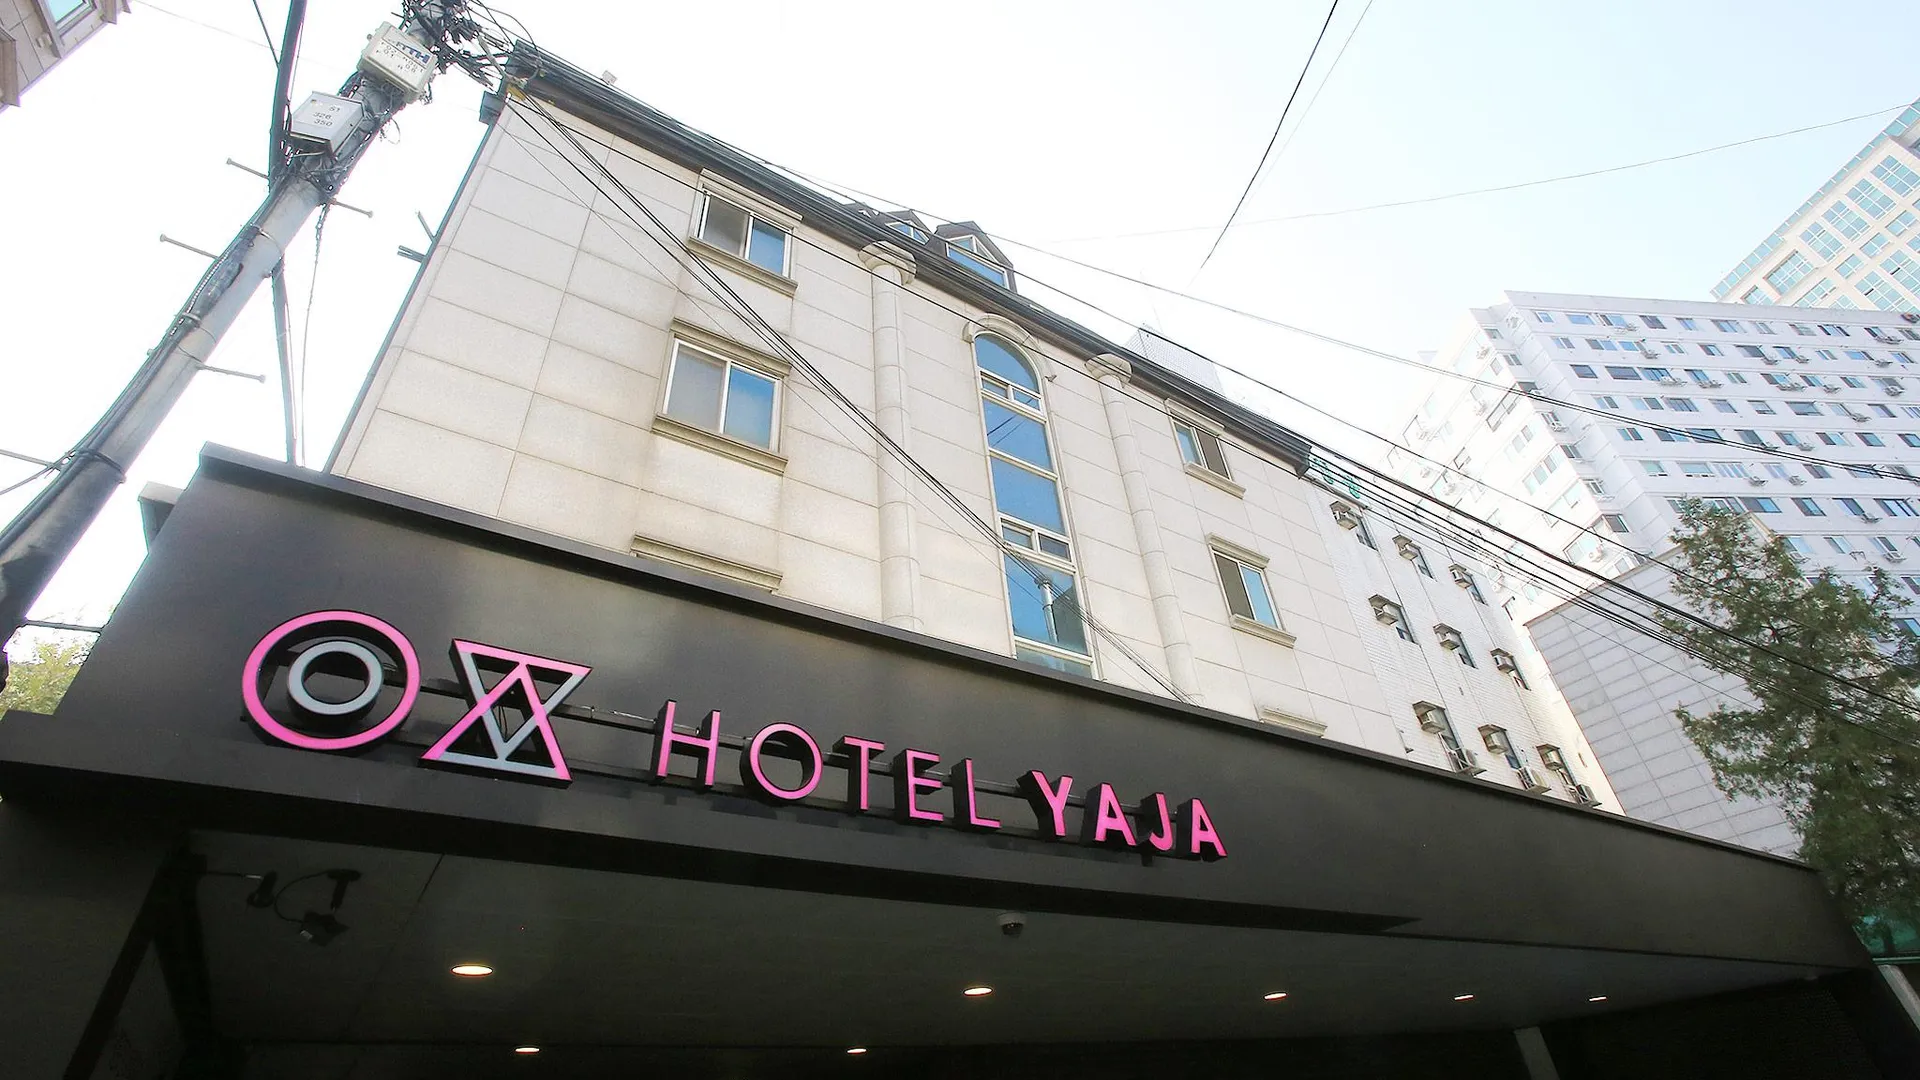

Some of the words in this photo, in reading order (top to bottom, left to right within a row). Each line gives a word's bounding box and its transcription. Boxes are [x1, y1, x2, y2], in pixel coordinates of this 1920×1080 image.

[314, 119, 333, 127] 350
[655, 700, 1002, 829] HOTEL
[1030, 769, 1228, 859] YAJA
